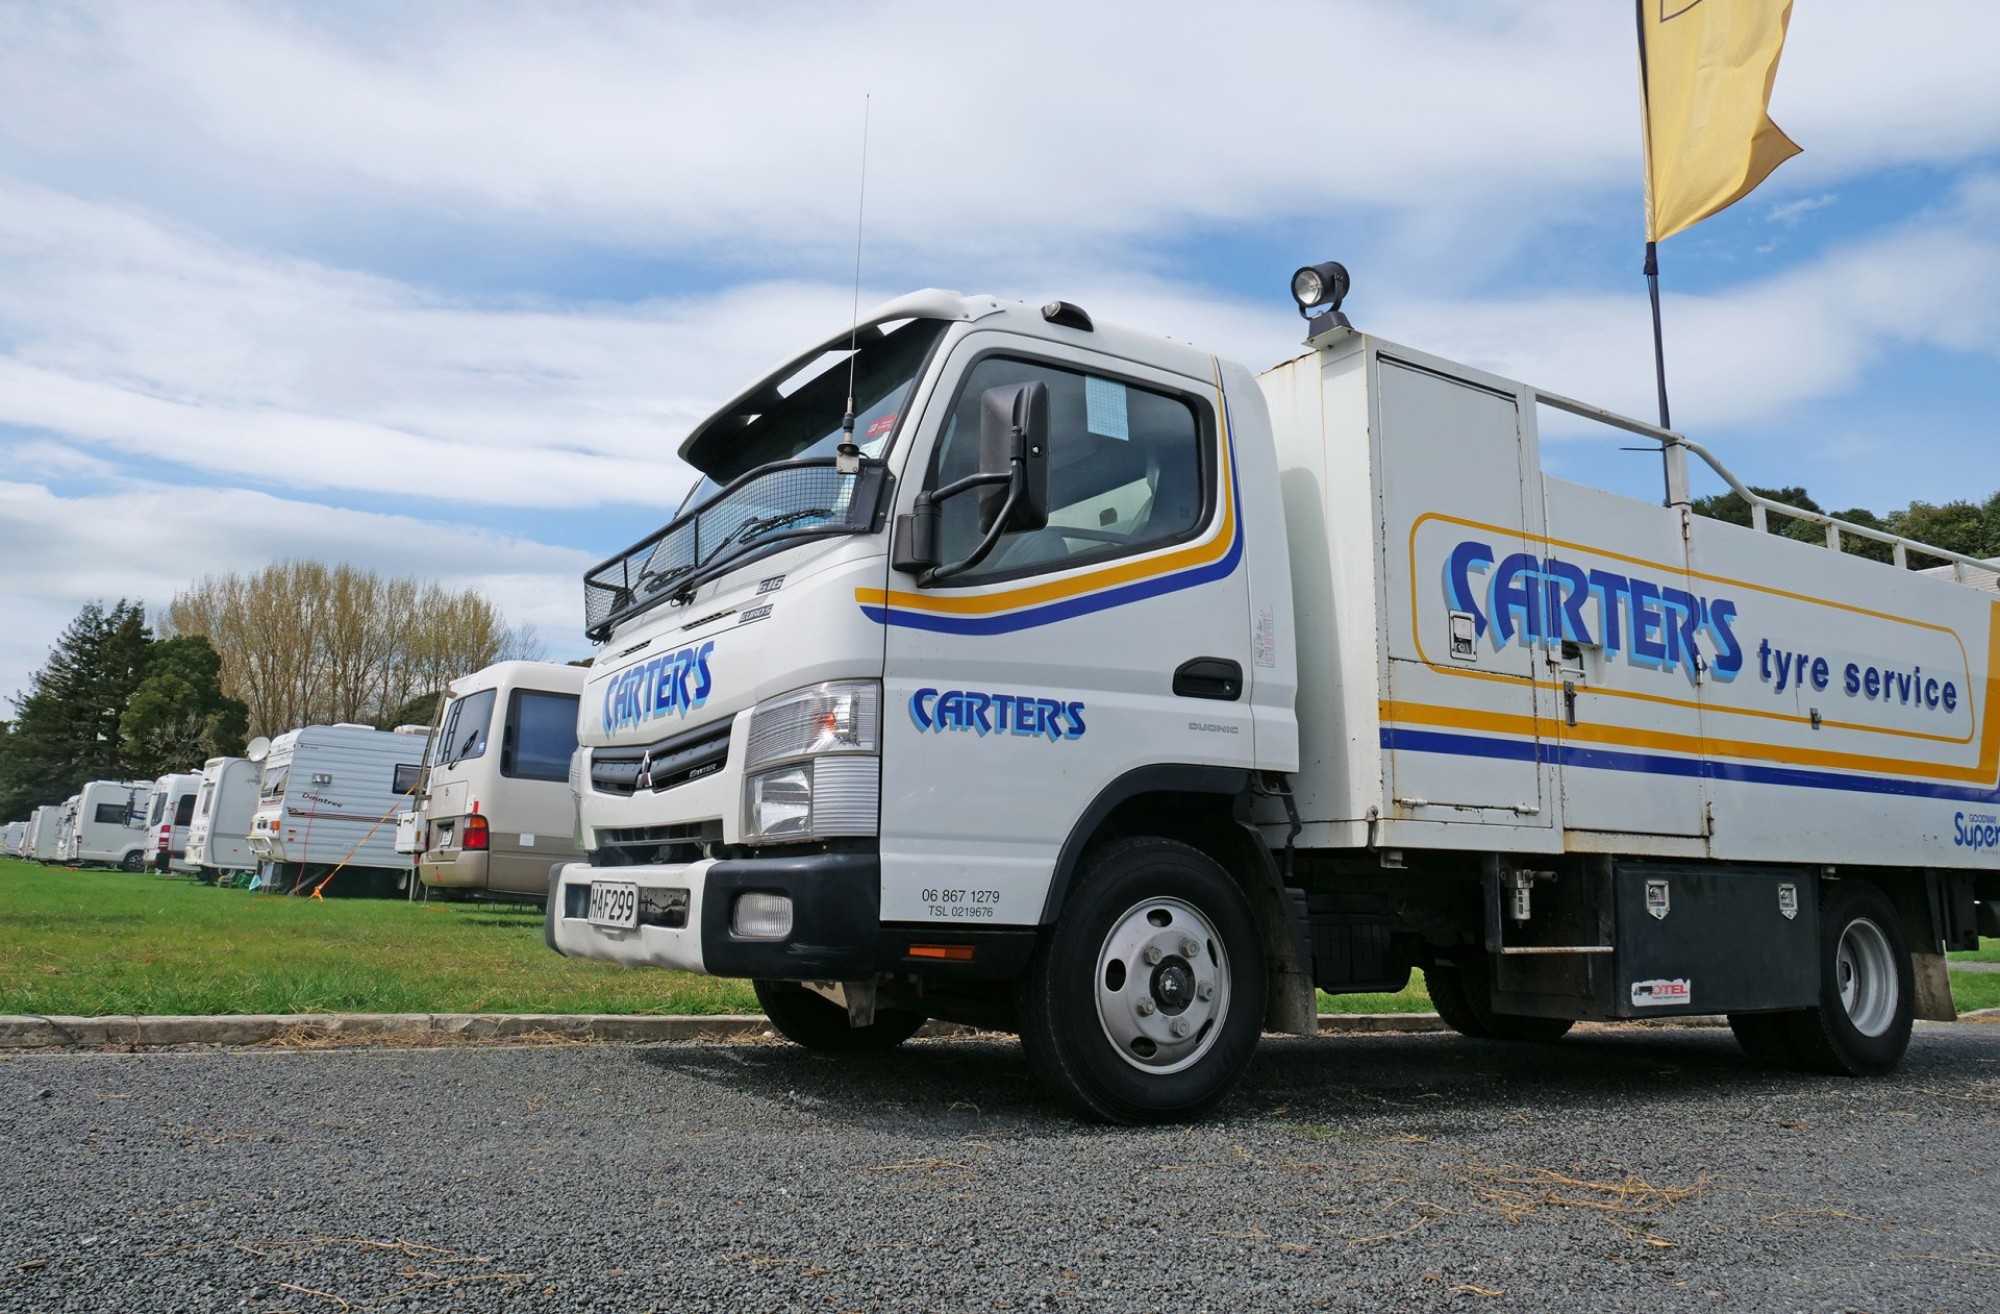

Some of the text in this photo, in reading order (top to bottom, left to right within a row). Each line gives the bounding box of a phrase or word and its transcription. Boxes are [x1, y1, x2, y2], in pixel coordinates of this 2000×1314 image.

[758, 576, 785, 594] 616
[1443, 541, 1743, 686] CARTER'S
[603, 641, 714, 739] CARTER'S
[1758, 638, 1957, 714] tyre service
[908, 688, 1086, 743] CARTER'S
[1188, 722, 1239, 734] DUONIC
[590, 889, 634, 921] HAF299
[922, 888, 1000, 904] 06 867 1279
[928, 905, 993, 917] TSL 0219676
